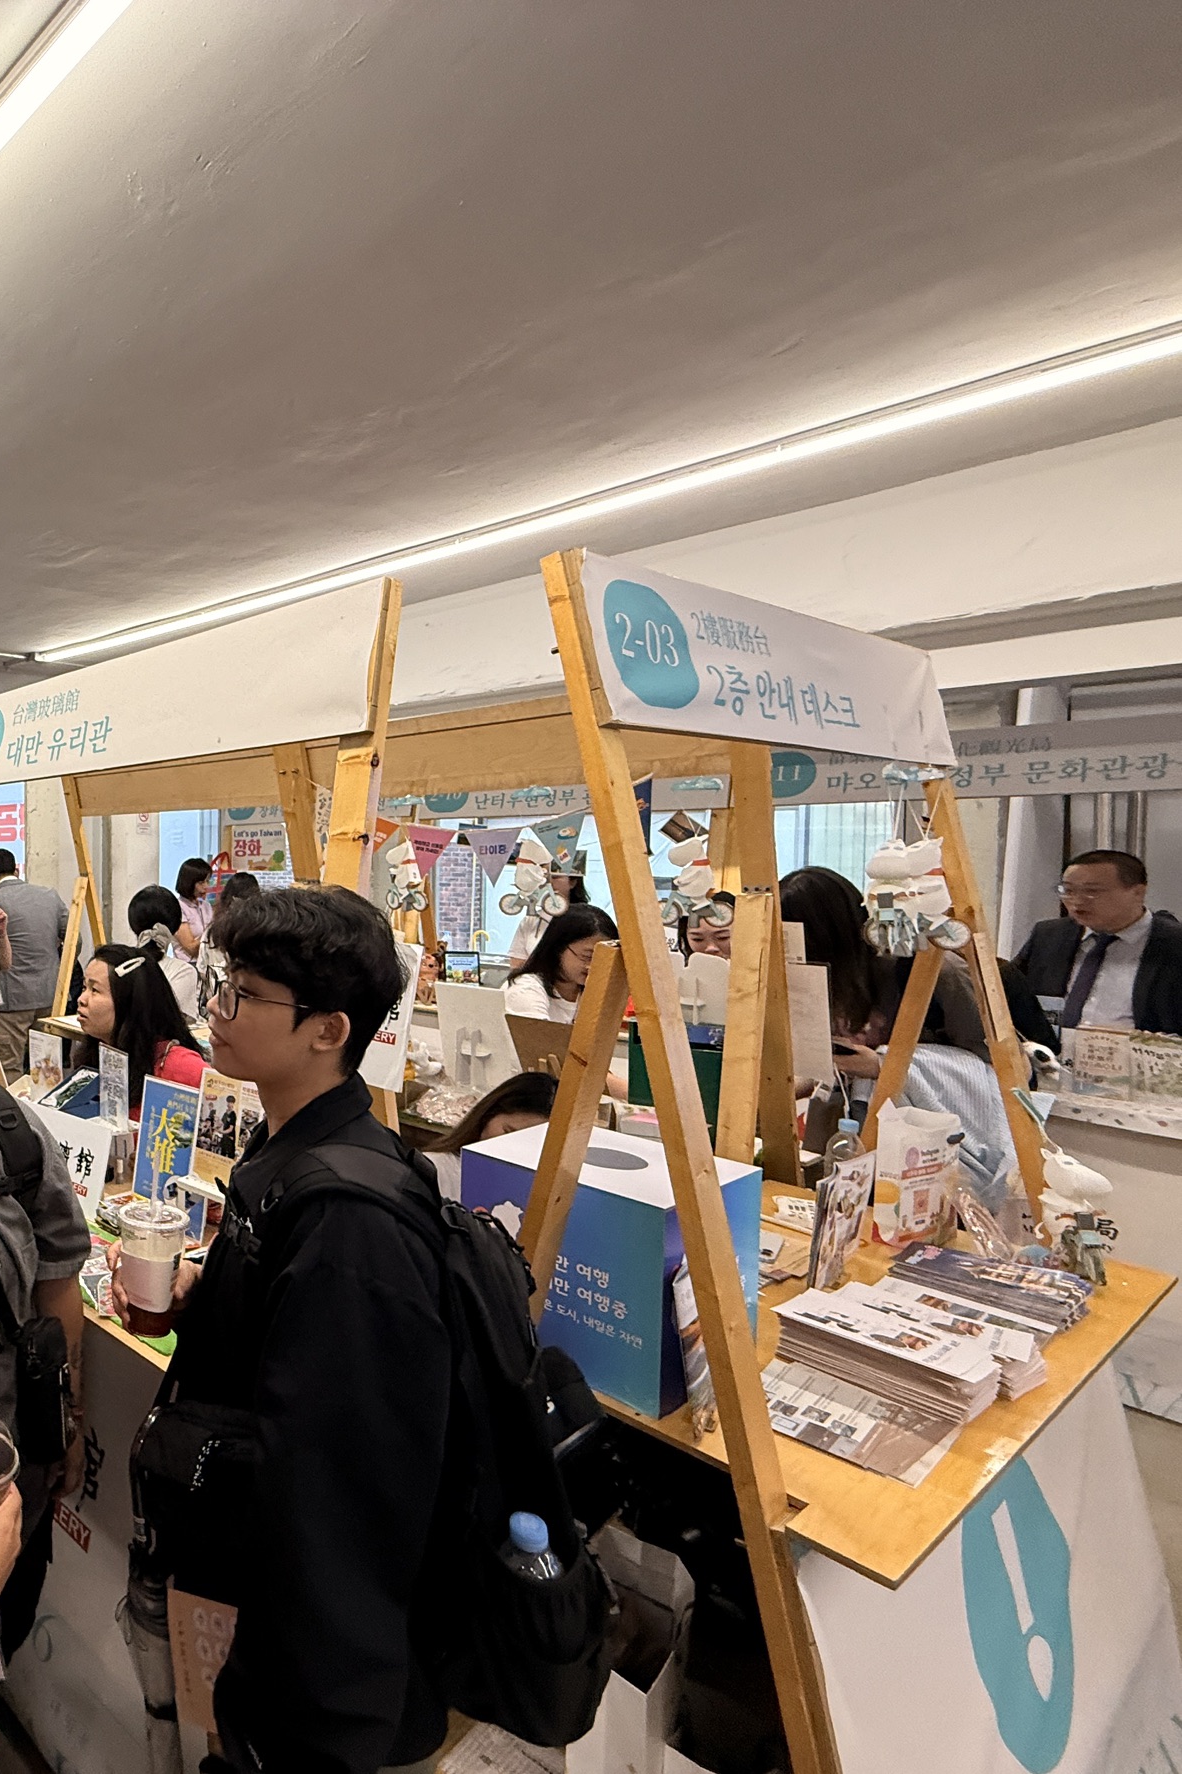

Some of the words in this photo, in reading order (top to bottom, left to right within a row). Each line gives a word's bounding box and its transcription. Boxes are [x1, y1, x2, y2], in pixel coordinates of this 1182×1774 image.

[615, 612, 679, 667] 2-03
[691, 610, 771, 657] 2樓服務台
[12, 688, 80, 726] 台灣玻璃館
[707, 665, 750, 715] 2층
[756, 670, 798, 725] 안내
[800, 683, 860, 728] 데스크
[6, 731, 43, 767] 대만
[47, 716, 112, 761] 유리관
[1021, 753, 1182, 784] 문화관광
[234, 839, 262, 857] 장화
[259, 829, 282, 837] Taiwan
[478, 844, 507, 855] 타이중
[576, 1263, 609, 1288] 여행
[577, 1287, 628, 1319] 여행중
[557, 1304, 579, 1324] 도시,
[583, 1315, 616, 1337] 내일은
[619, 1330, 642, 1350] 자연
